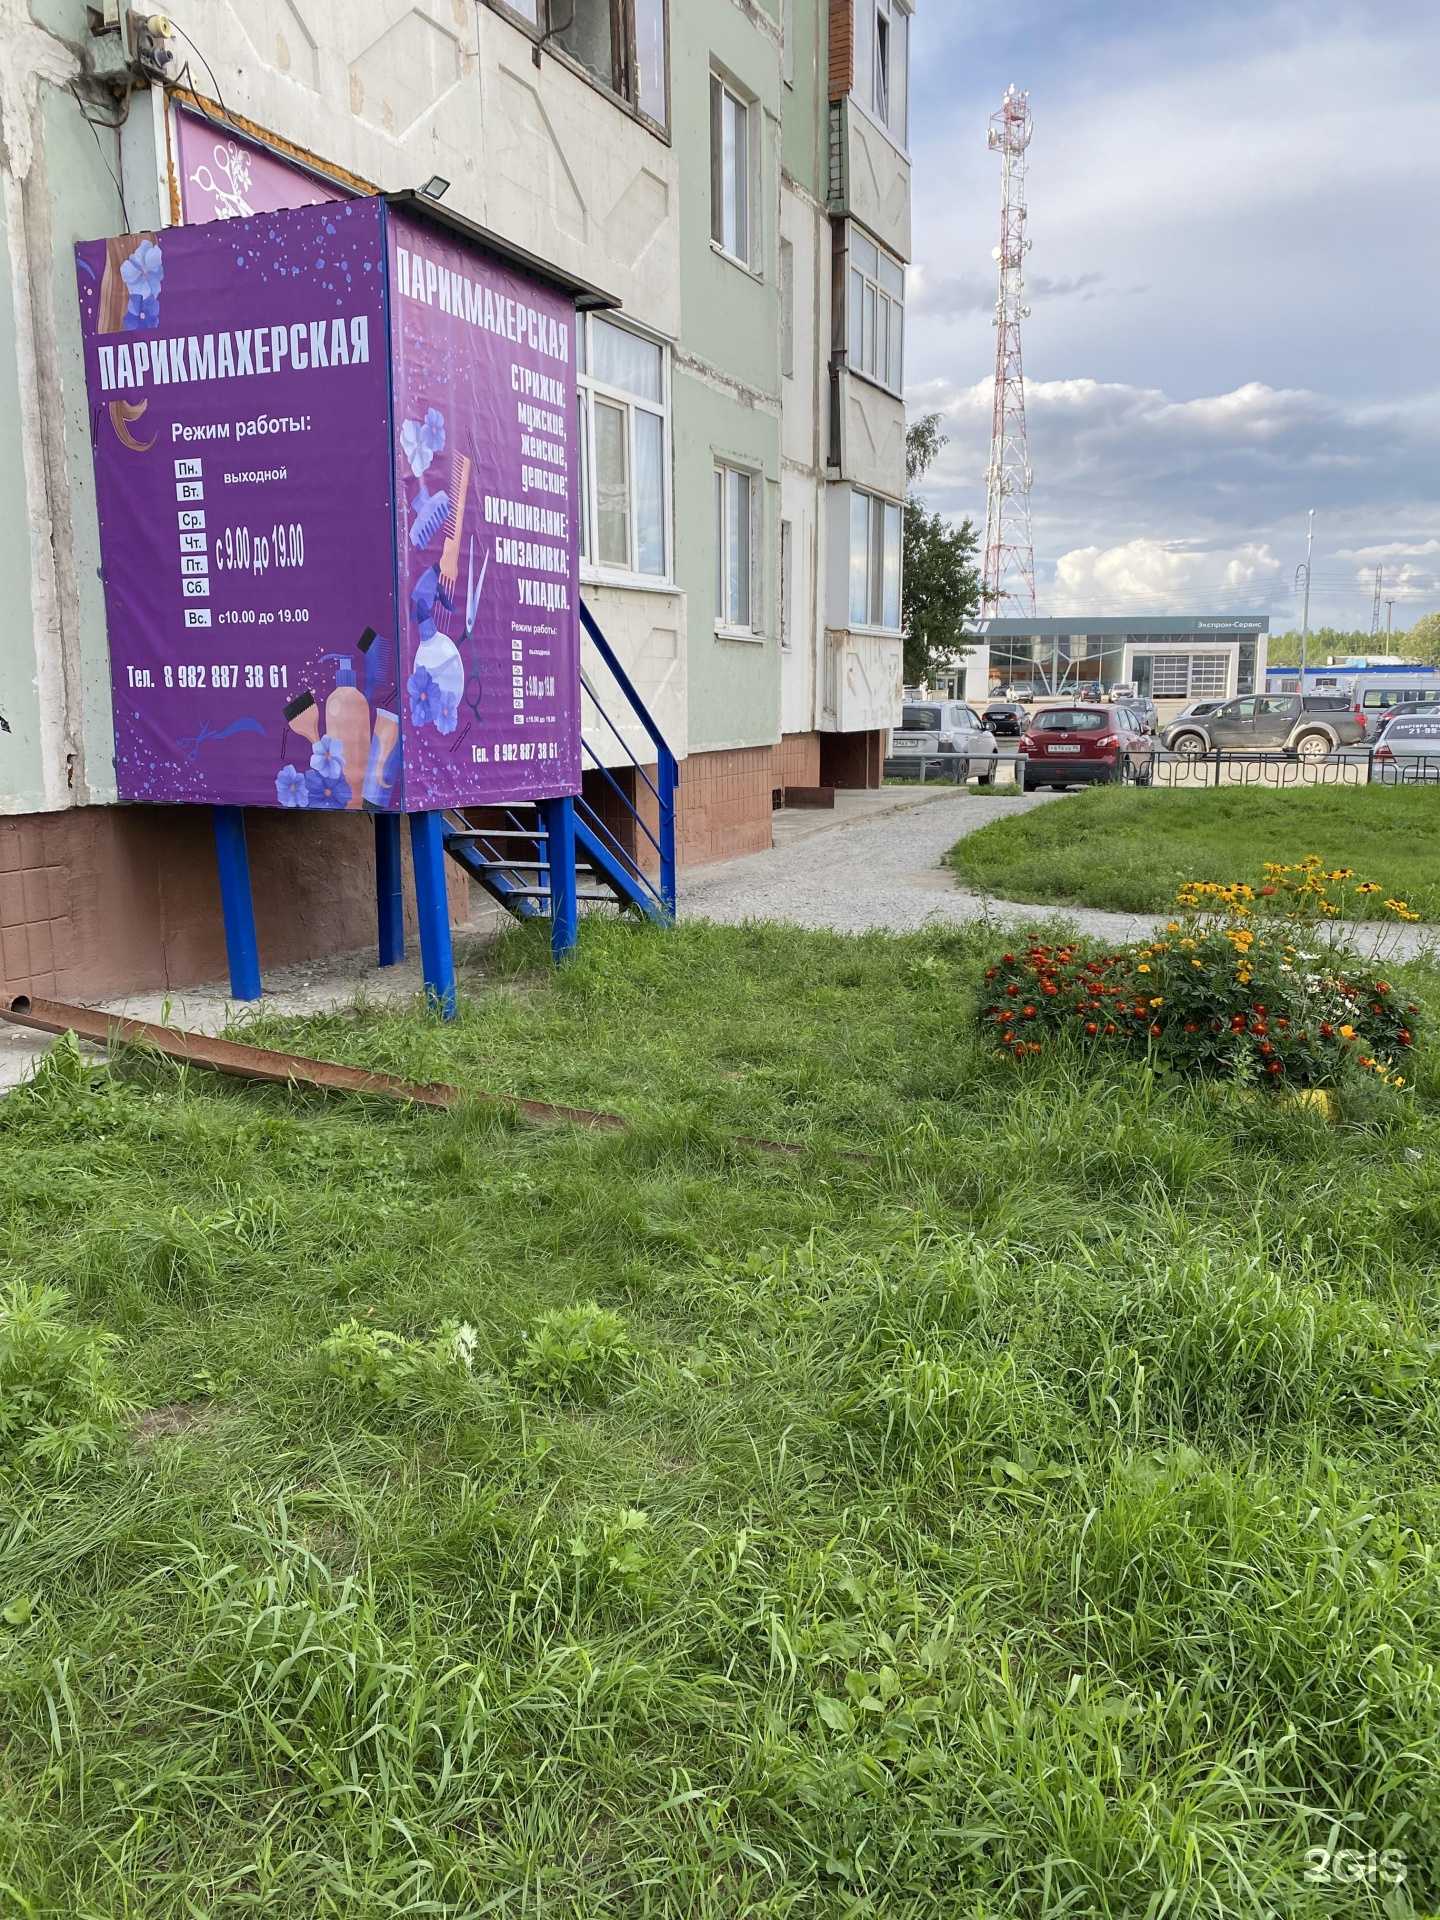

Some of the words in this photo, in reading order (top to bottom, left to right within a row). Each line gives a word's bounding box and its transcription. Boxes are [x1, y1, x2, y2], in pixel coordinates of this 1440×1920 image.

[396, 246, 568, 364] ПАРИКМАХЕРСКАЯ
[97, 315, 370, 391] ПАРИКМАХЕРСКАЯ
[511, 363, 566, 409] СТРИЖКИ:
[171, 421, 230, 442] Режим
[235, 413, 311, 441] работы:
[517, 402, 567, 442] мужские,
[521, 435, 568, 469] женские,
[179, 462, 198, 476] Пн.
[224, 466, 287, 483] выходной
[182, 485, 199, 498] Вт.
[182, 513, 201, 528] Ср.
[484, 495, 569, 543] ОКРАШИВАНИЕ;
[185, 537, 202, 550] Чт.
[215, 538, 224, 570] с
[225, 527, 251, 569] 9.00
[253, 536, 269, 575] до
[272, 523, 304, 567] 19.00
[186, 559, 203, 572] Пт.
[495, 536, 570, 577] БИОЗАВИВКА;
[186, 580, 206, 594] Сб.
[517, 577, 570, 612] УКЛАДКА.
[189, 612, 207, 625] Вс.
[218, 610, 255, 624] с10.00
[258, 612, 275, 625] до
[278, 608, 309, 622] 19.00
[511, 621, 533, 633] Режим
[533, 624, 557, 635] работы:
[126, 665, 155, 688] Тел.
[164, 665, 172, 688] 8
[178, 665, 206, 688] 982
[212, 665, 239, 688] 887
[244, 665, 264, 688] 38
[270, 665, 288, 688] 61
[471, 745, 489, 763] Тел.
[494, 744, 500, 762] 8
[502, 744, 517, 761] 982
[519, 743, 535, 760] 887
[537, 742, 547, 759] 38
[549, 742, 558, 759] 61
